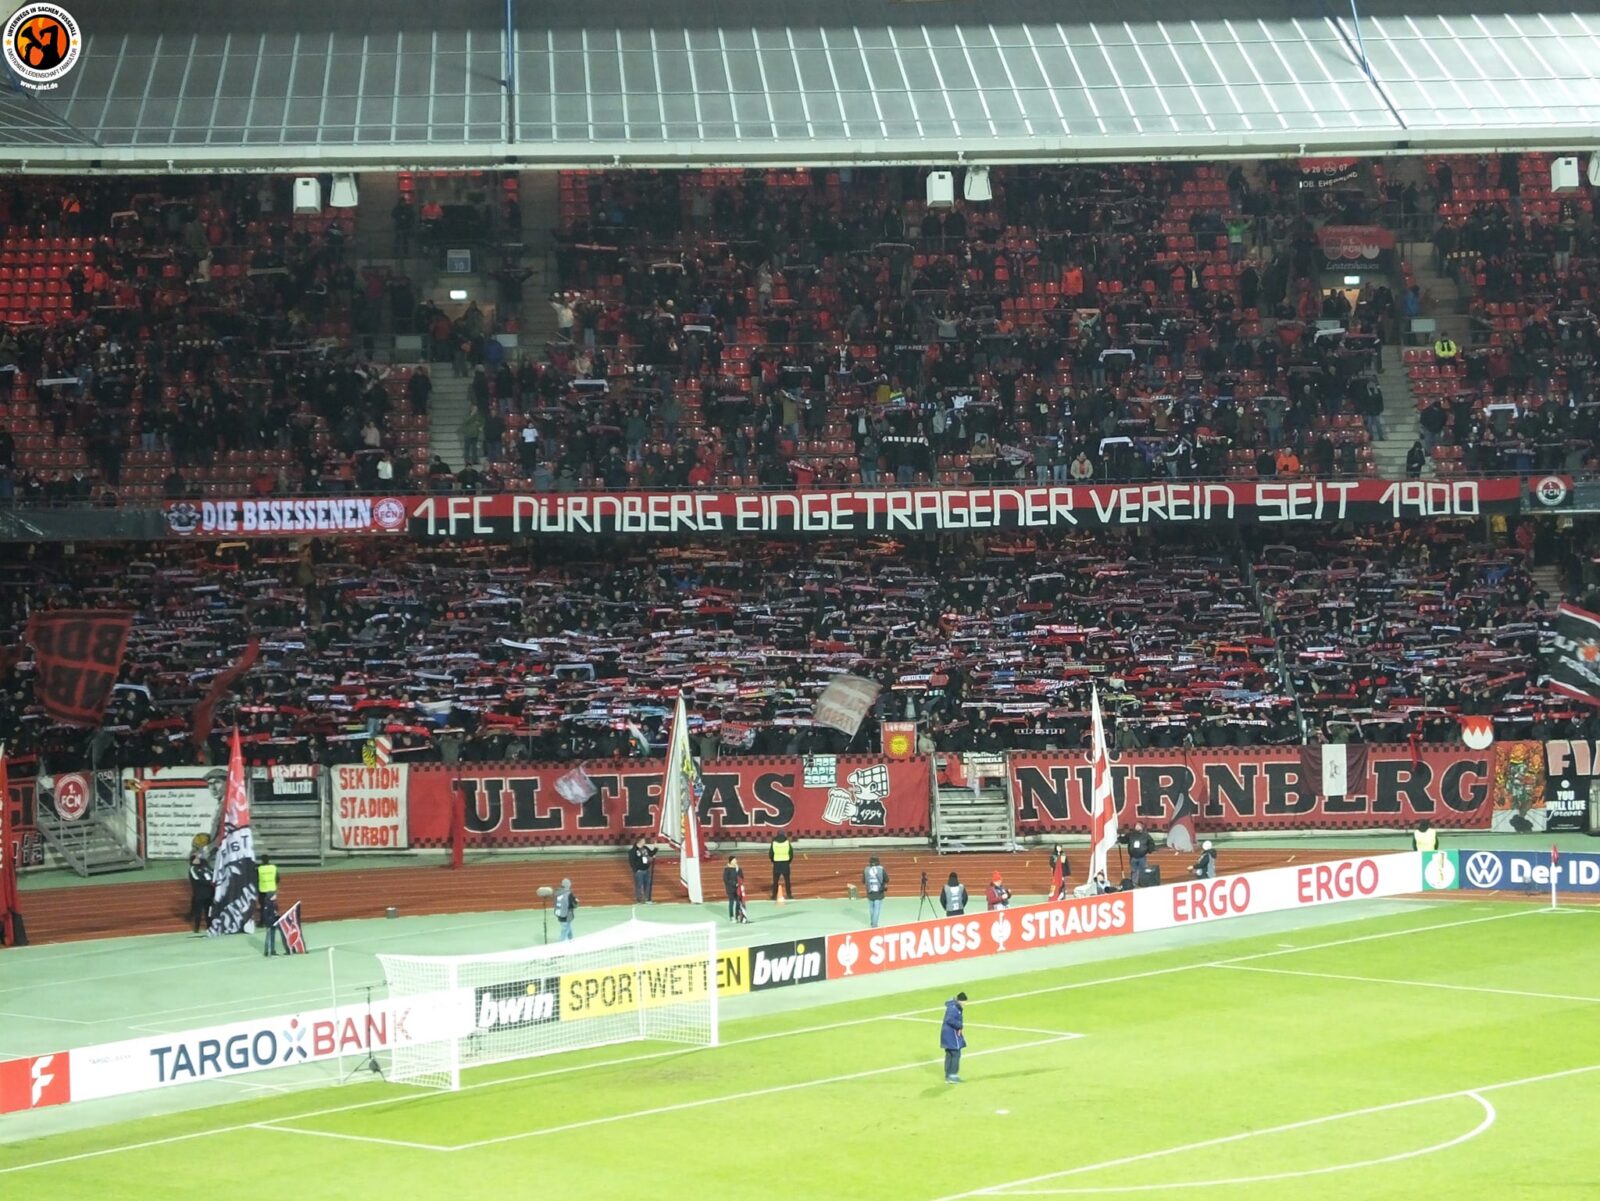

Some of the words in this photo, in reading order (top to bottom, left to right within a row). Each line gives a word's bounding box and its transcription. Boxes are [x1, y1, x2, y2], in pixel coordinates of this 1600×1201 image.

[735, 487, 1078, 531] EINGETRAGENER
[1089, 484, 1234, 524] VEREIN
[1255, 481, 1359, 522] SEIT
[1378, 480, 1479, 516] 1900
[1543, 488, 1560, 496] FCN
[201, 501, 237, 532] DIE
[242, 499, 372, 531] BESESSENEN
[338, 767, 400, 790] SEKTION
[1014, 750, 1489, 821] NÜRNBRG
[1556, 790, 1575, 800] YOU
[61, 794, 81, 808] FCN
[340, 797, 399, 819] STADION
[860, 809, 882, 821] 1994
[1567, 800, 1586, 810] LIVE
[341, 825, 399, 847] VERBOT
[1296, 859, 1379, 903] ERGO
[1510, 858, 1562, 884] Der
[1172, 877, 1251, 922] ERGO
[1021, 900, 1126, 942] STRAUSS
[869, 921, 982, 965] STRAUSS
[753, 943, 821, 987] bwin
[569, 956, 742, 1013] SPORTWETTEN
[477, 984, 554, 1030] bwin
